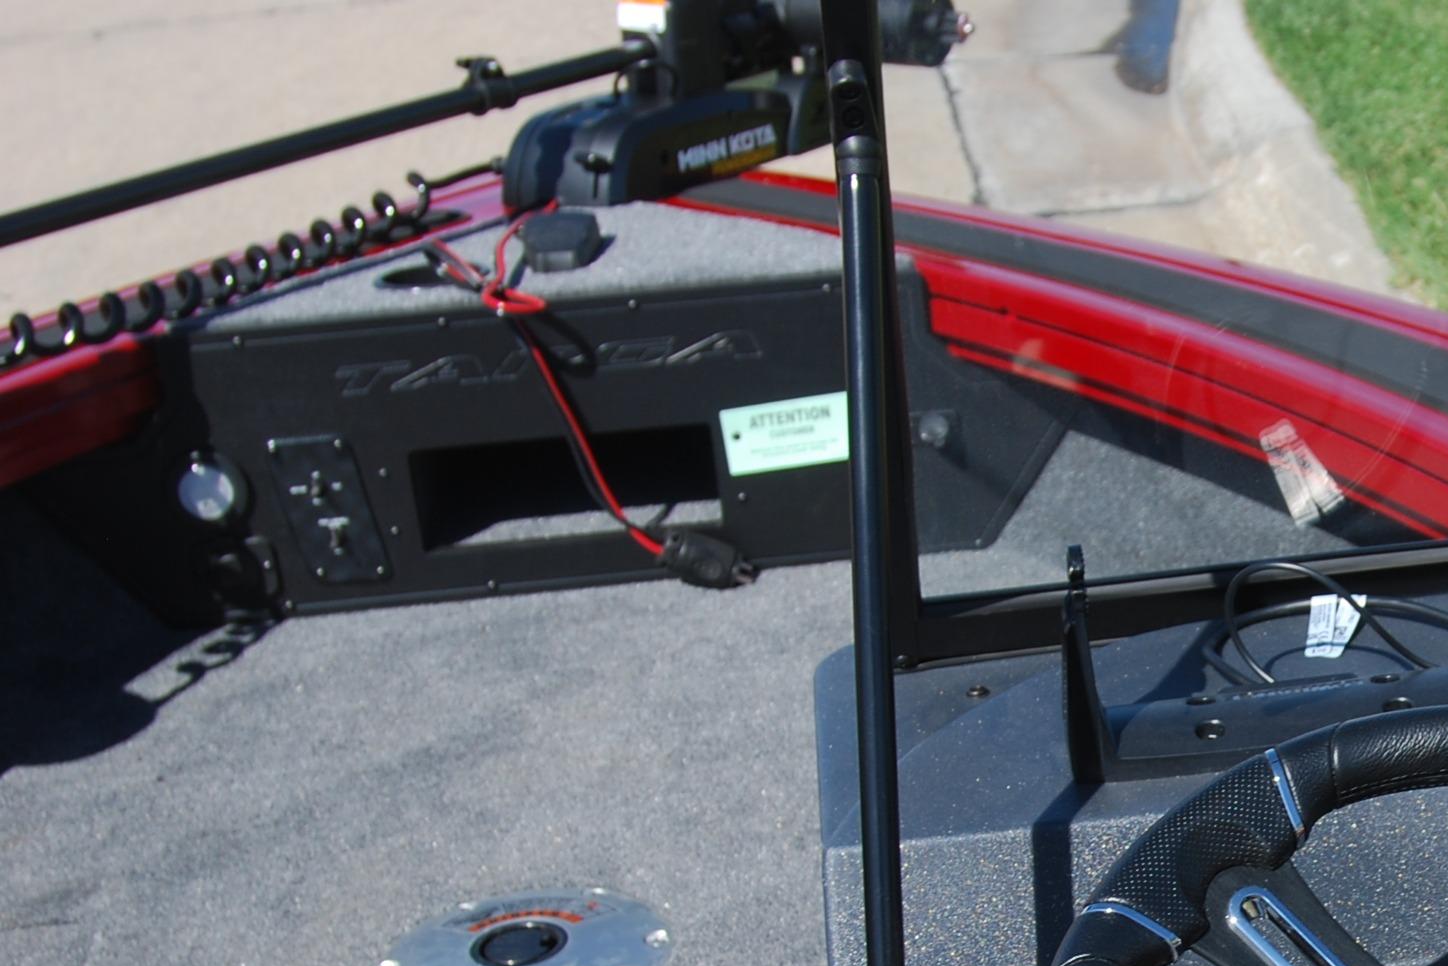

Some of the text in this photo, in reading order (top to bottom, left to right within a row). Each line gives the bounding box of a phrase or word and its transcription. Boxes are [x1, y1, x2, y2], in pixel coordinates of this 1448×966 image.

[677, 137, 728, 174] MINN
[729, 123, 776, 156] KOTA
[749, 405, 831, 430] ATTENTION
